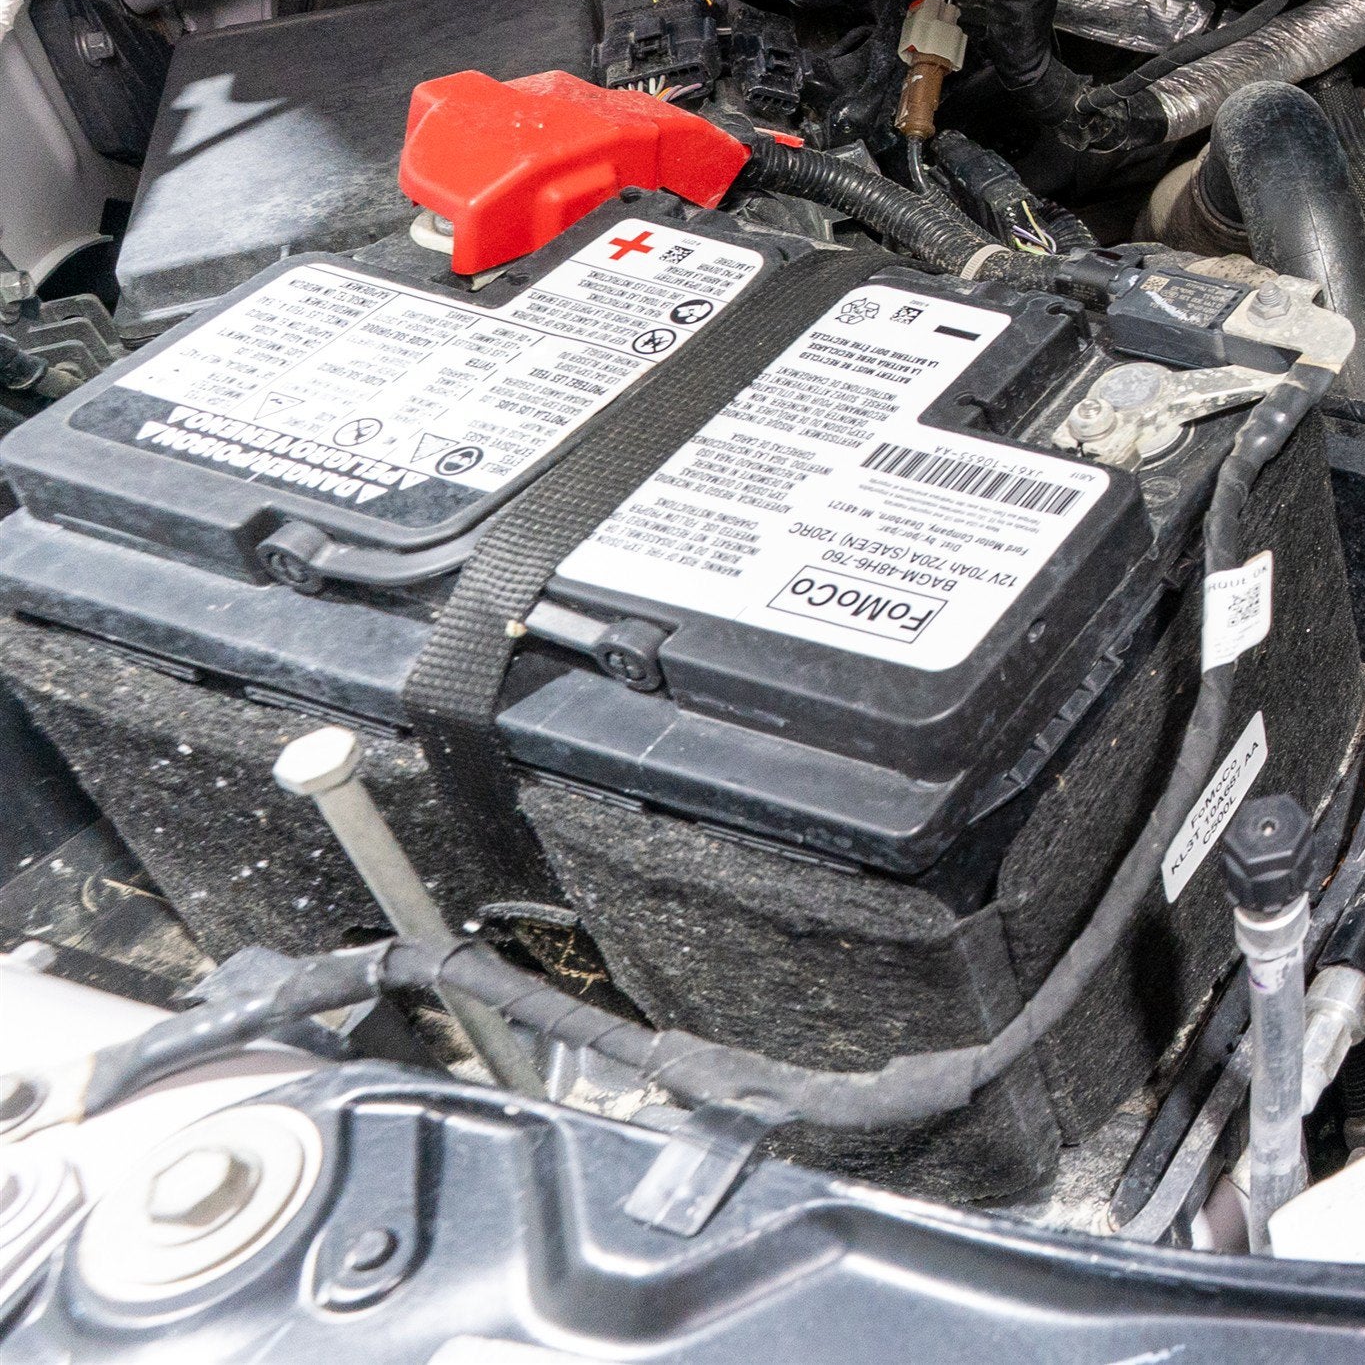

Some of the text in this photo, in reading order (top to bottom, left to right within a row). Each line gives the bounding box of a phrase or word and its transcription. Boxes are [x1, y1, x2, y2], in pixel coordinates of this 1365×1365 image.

[799, 351, 840, 367] RECYCLED
[822, 549, 957, 592] BAGM-48H6-760
[986, 572, 1018, 588] 12V
[791, 578, 933, 632] FoMoCo
[1171, 832, 1198, 872] KL3T
[1245, 742, 1258, 761] AA
[1191, 759, 1236, 826] FoMoCo
[1203, 798, 1233, 843] C500L
